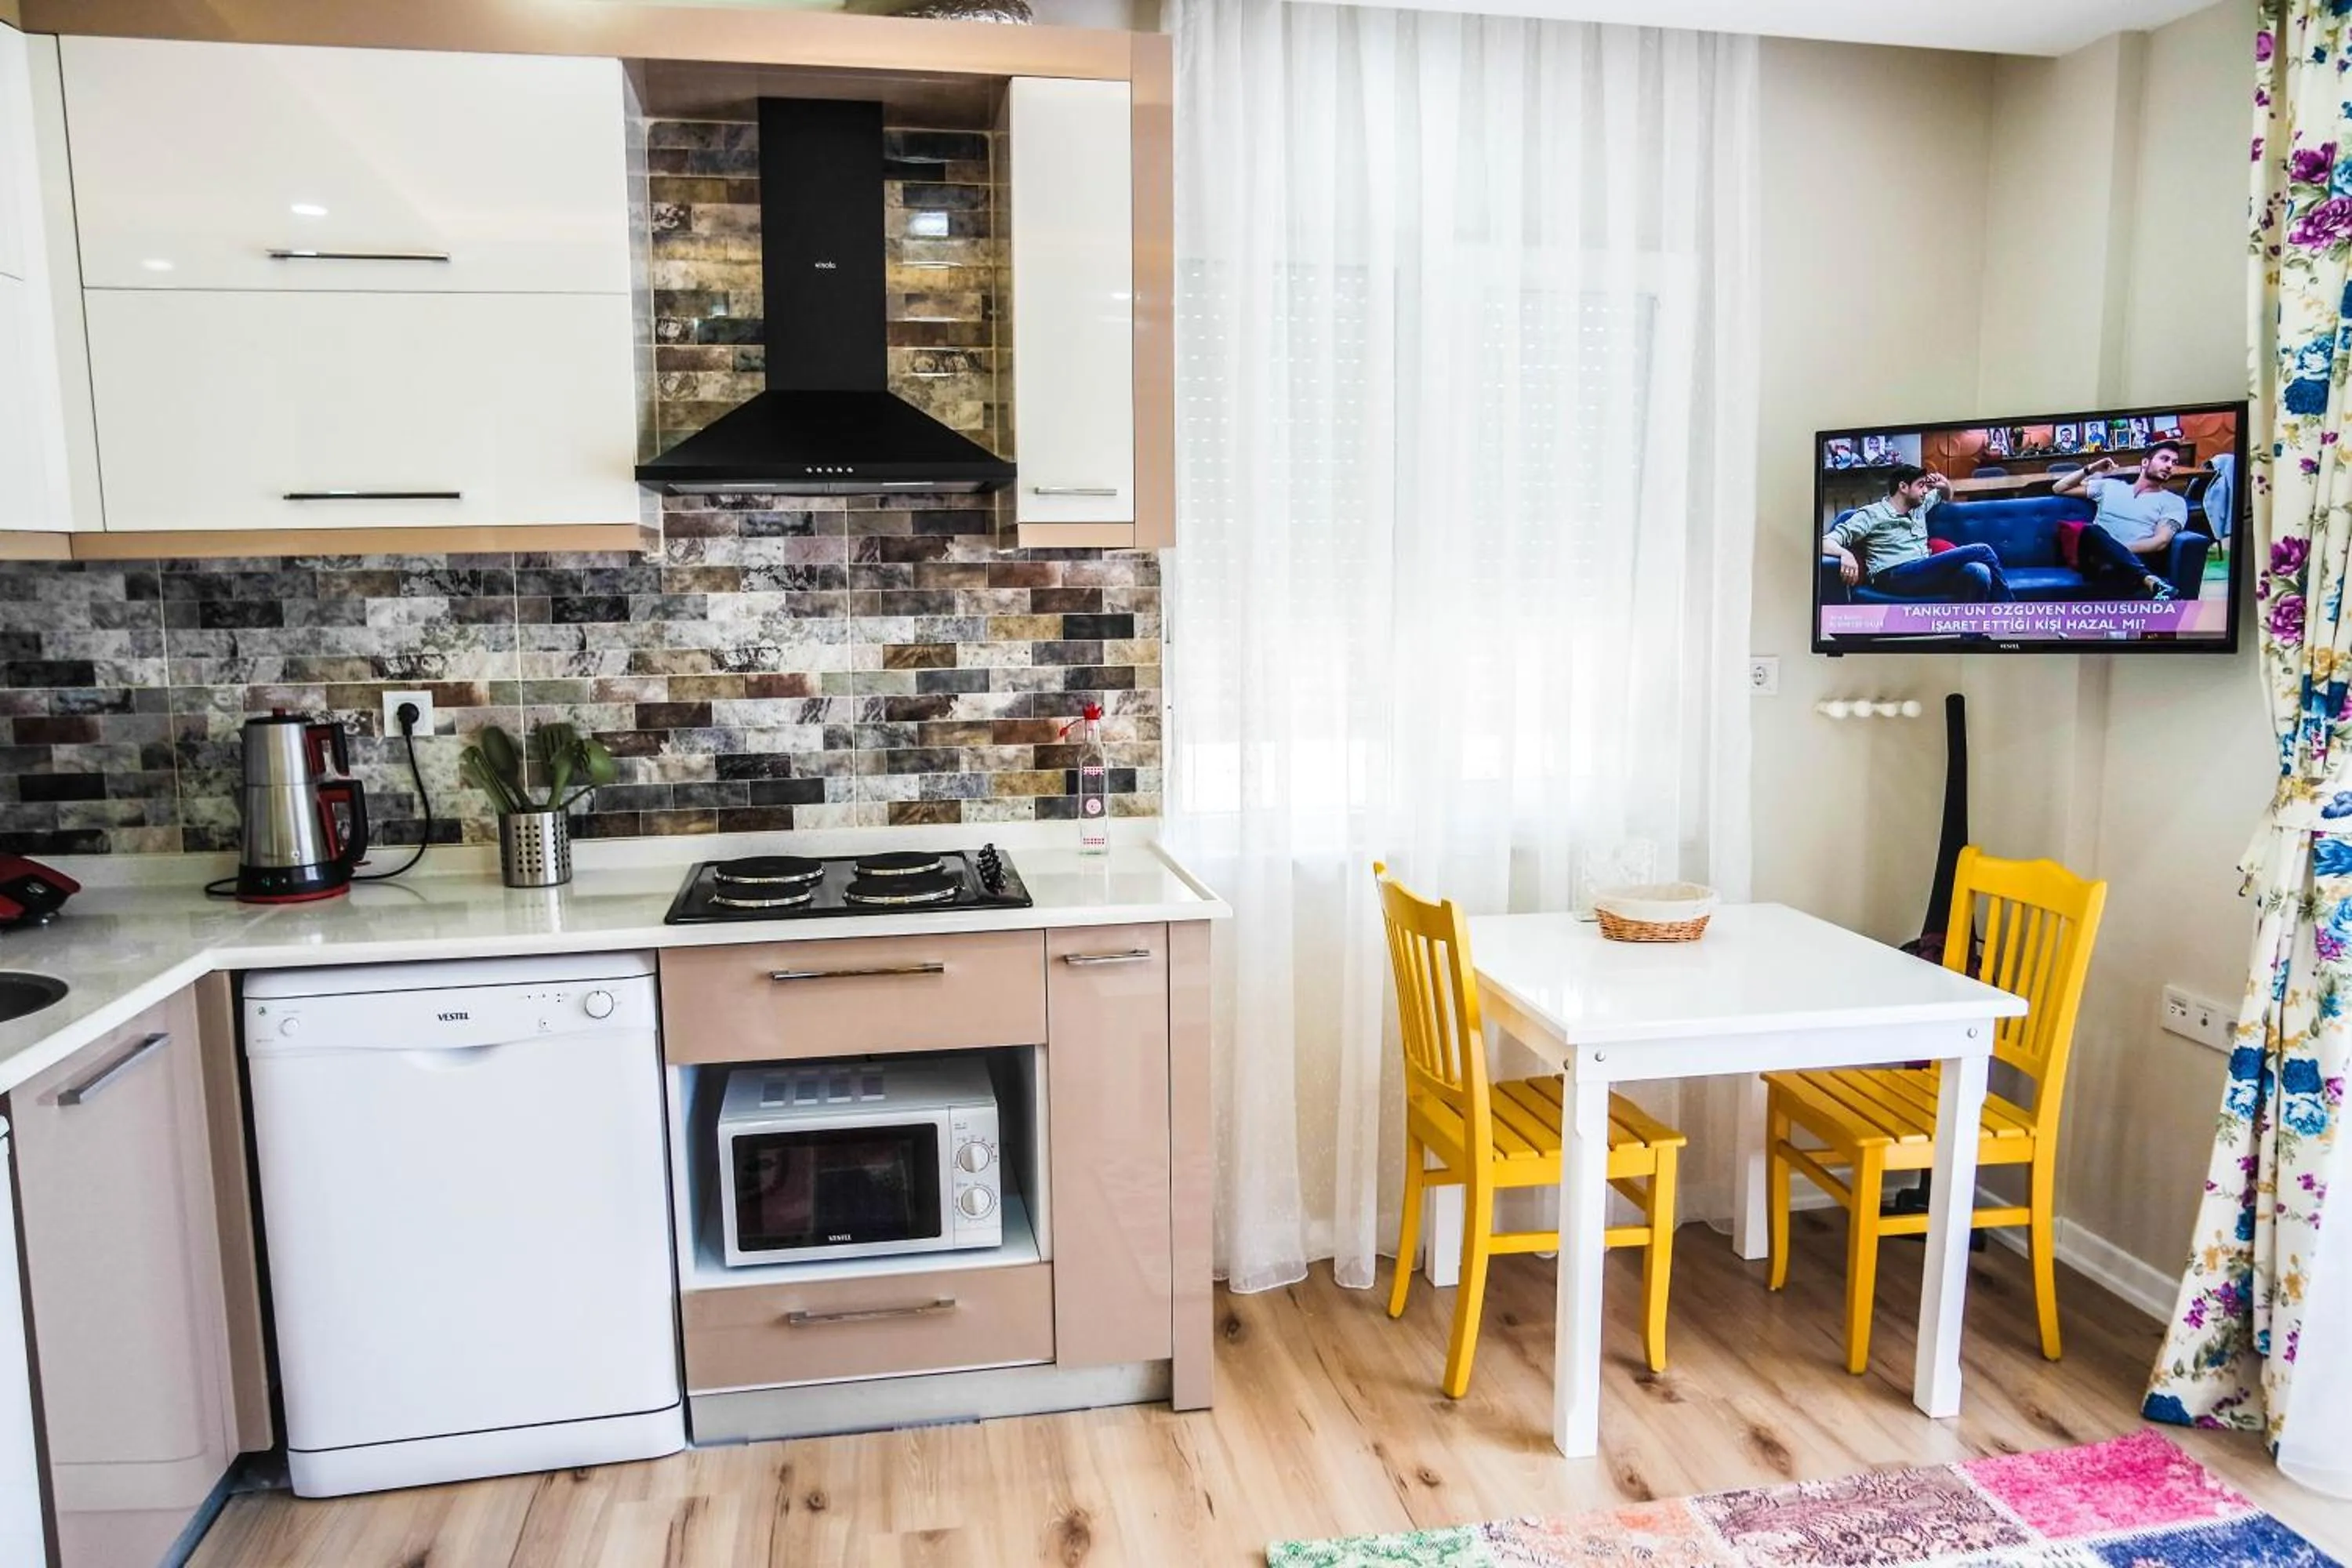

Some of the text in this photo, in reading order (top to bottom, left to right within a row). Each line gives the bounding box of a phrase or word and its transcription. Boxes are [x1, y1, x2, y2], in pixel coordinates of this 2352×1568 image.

[2071, 603, 2176, 615] KONUSUNDA
[2066, 619, 2116, 630] HAZAL
[437, 1012, 470, 1022] VESTEL
